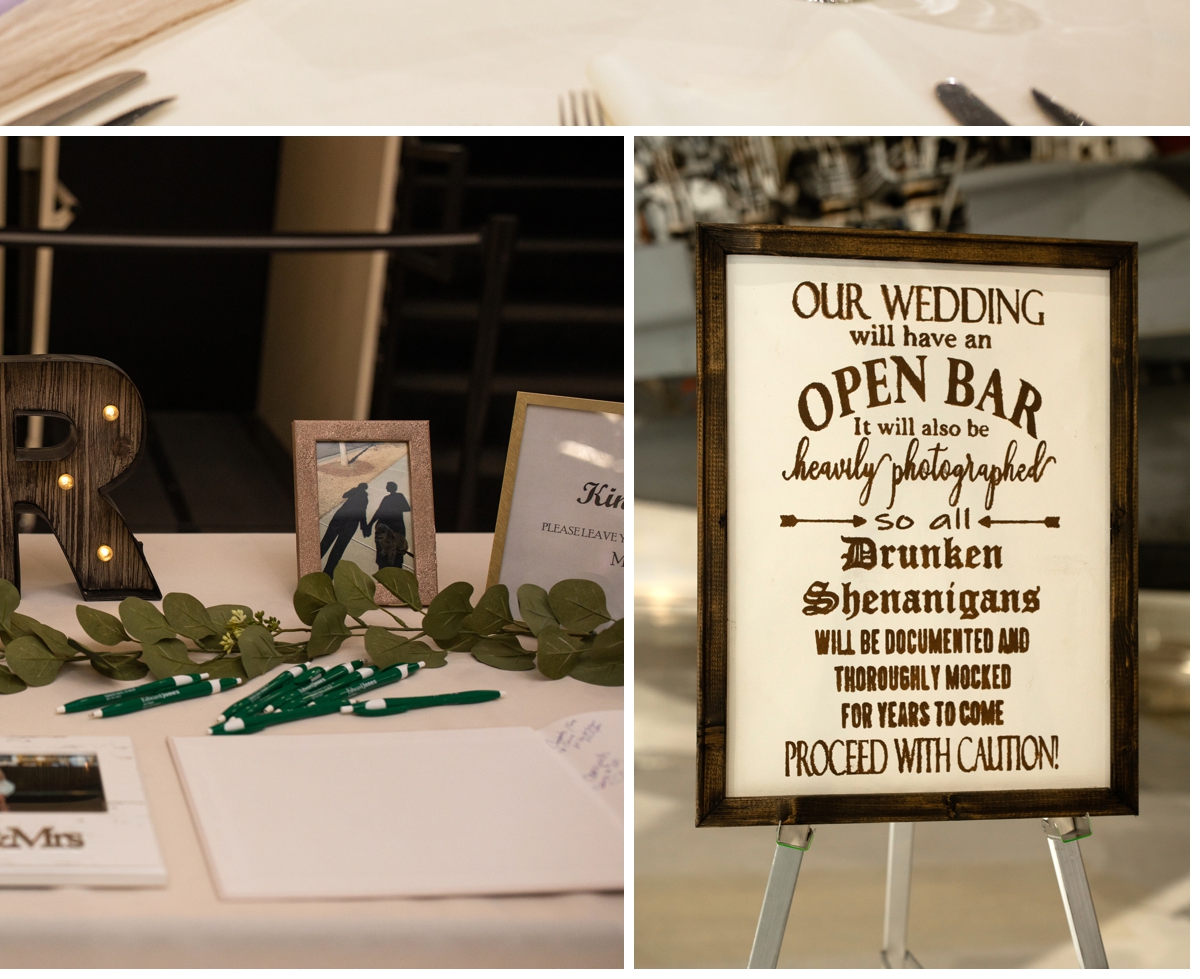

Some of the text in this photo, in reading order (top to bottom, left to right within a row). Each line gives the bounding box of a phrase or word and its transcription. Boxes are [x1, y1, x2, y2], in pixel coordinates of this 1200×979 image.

[792, 281, 1045, 325] OUR WEDDING
[849, 324, 992, 349] will have an
[798, 355, 1043, 439] OPEN BAR
[854, 417, 990, 437] It will also be
[782, 436, 1057, 511] heavily photographed
[541, 522, 580, 537] PLEASE
[581, 527, 618, 543] LEAVE
[874, 507, 971, 531] so all
[840, 535, 1003, 571] Drunken
[801, 580, 1041, 621] Shenanigans
[814, 627, 1030, 656] WILL BE DOCUMENTED AND
[834, 663, 1012, 693] THOROUGHLY MOCKED
[841, 700, 1005, 729] FOR YEARS TO COME
[784, 734, 1060, 777] PROCEED WITH CAUTION!
